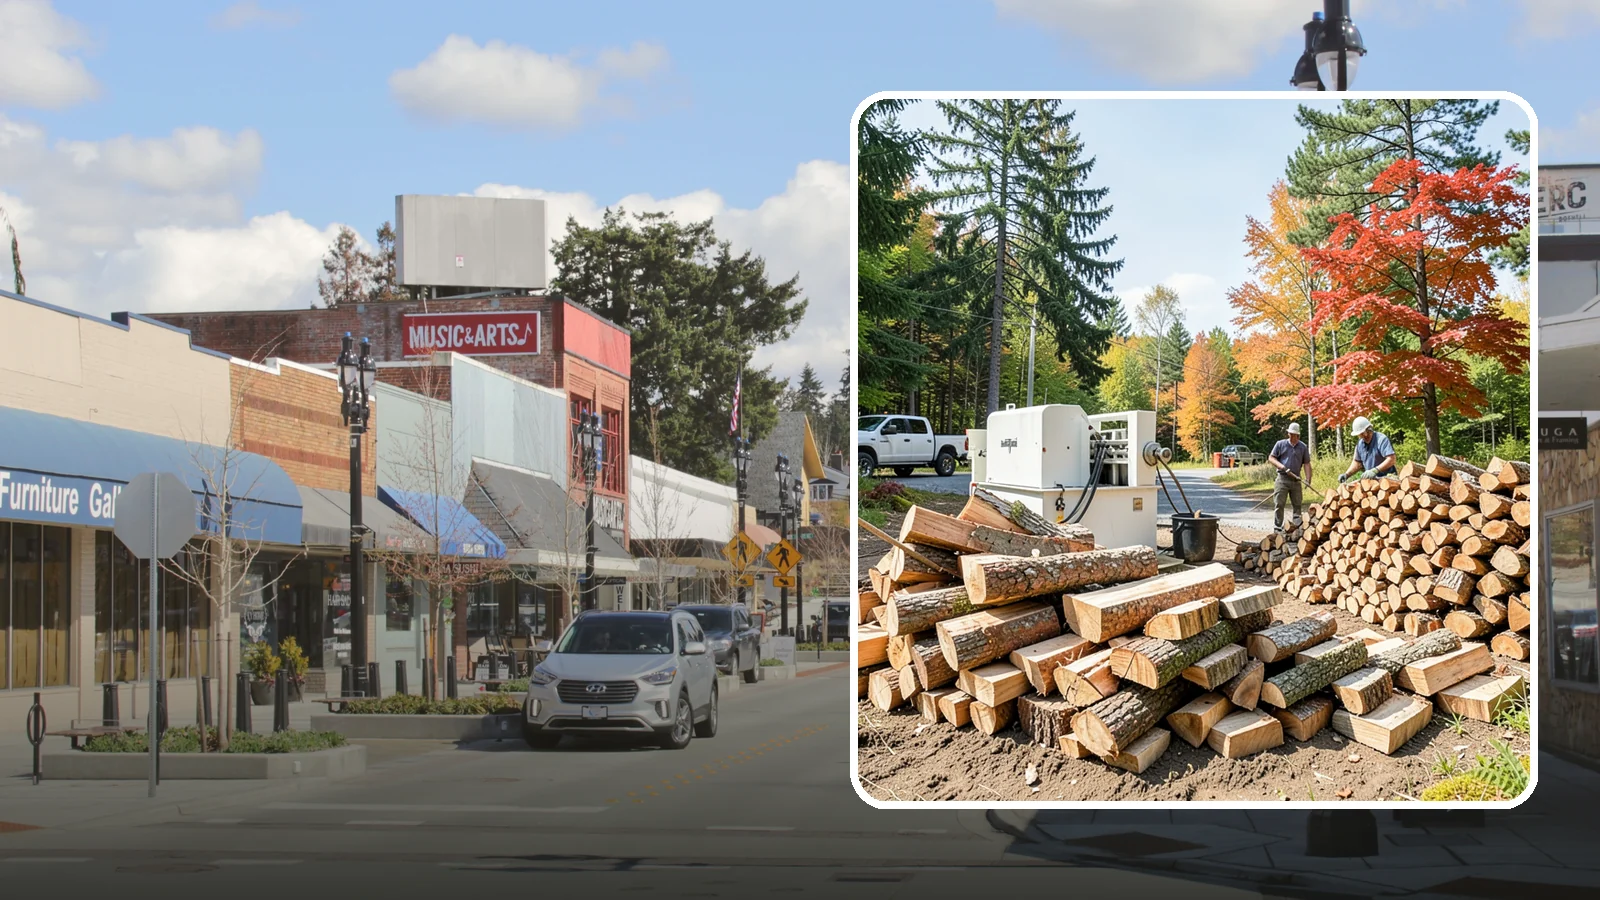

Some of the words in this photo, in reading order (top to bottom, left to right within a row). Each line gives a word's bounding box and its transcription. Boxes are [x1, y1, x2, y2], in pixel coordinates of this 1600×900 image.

[1540, 427, 1577, 436] UGA
[0, 472, 79, 515] Furniture
[453, 563, 479, 573] SUSHI
